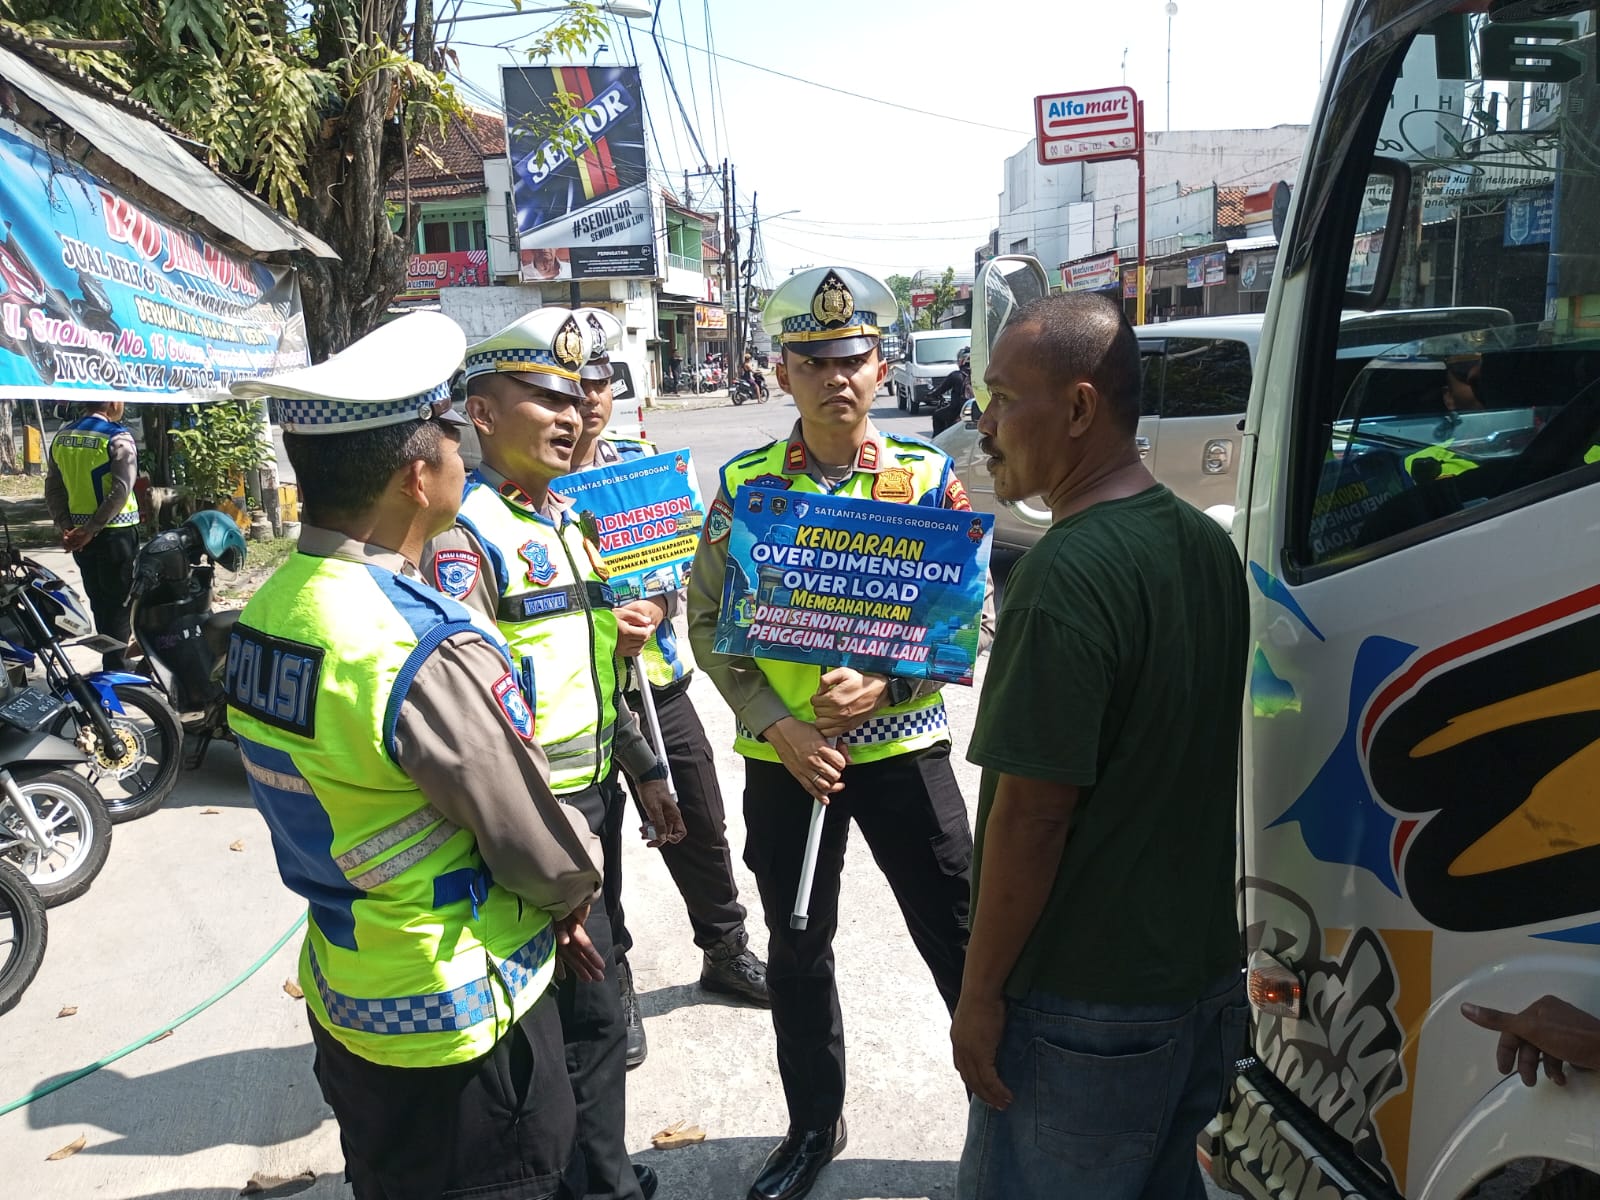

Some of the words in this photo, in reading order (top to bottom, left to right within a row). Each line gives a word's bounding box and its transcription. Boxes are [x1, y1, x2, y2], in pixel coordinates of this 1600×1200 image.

[1048, 96, 1128, 118] Alfamart
[573, 200, 632, 239] #SEDULUR
[63, 238, 109, 278] JUAL
[107, 253, 142, 288] BELI
[116, 330, 147, 357] No.
[559, 480, 602, 496] SATLANTAS
[602, 474, 628, 486] POLRES
[629, 464, 670, 479] GROBOGAN
[604, 496, 692, 531] DIMENSION
[814, 506, 867, 521] SATLANTAS
[869, 513, 903, 525] POLRES
[904, 519, 960, 532] GROBOGAN
[599, 532, 632, 551] VER
[633, 518, 678, 543] LOAD
[795, 525, 925, 561] KENDARAAN
[612, 558, 649, 573] UTAMAKAN
[650, 545, 696, 563] KESELAMATAN
[752, 543, 815, 567] OVER
[820, 550, 962, 584] DIMENSION
[783, 571, 847, 596] OVER
[852, 578, 919, 602] LOAD
[790, 589, 912, 621] MEMBAHAYAKAN
[755, 606, 789, 623] DIRI
[790, 610, 855, 632] SENDIRI
[855, 620, 928, 642] MAUPUN
[747, 624, 835, 650] PENGGUNA
[837, 637, 890, 657] JALAN
[890, 644, 930, 662] LAIN
[224, 633, 315, 727] POLISI
